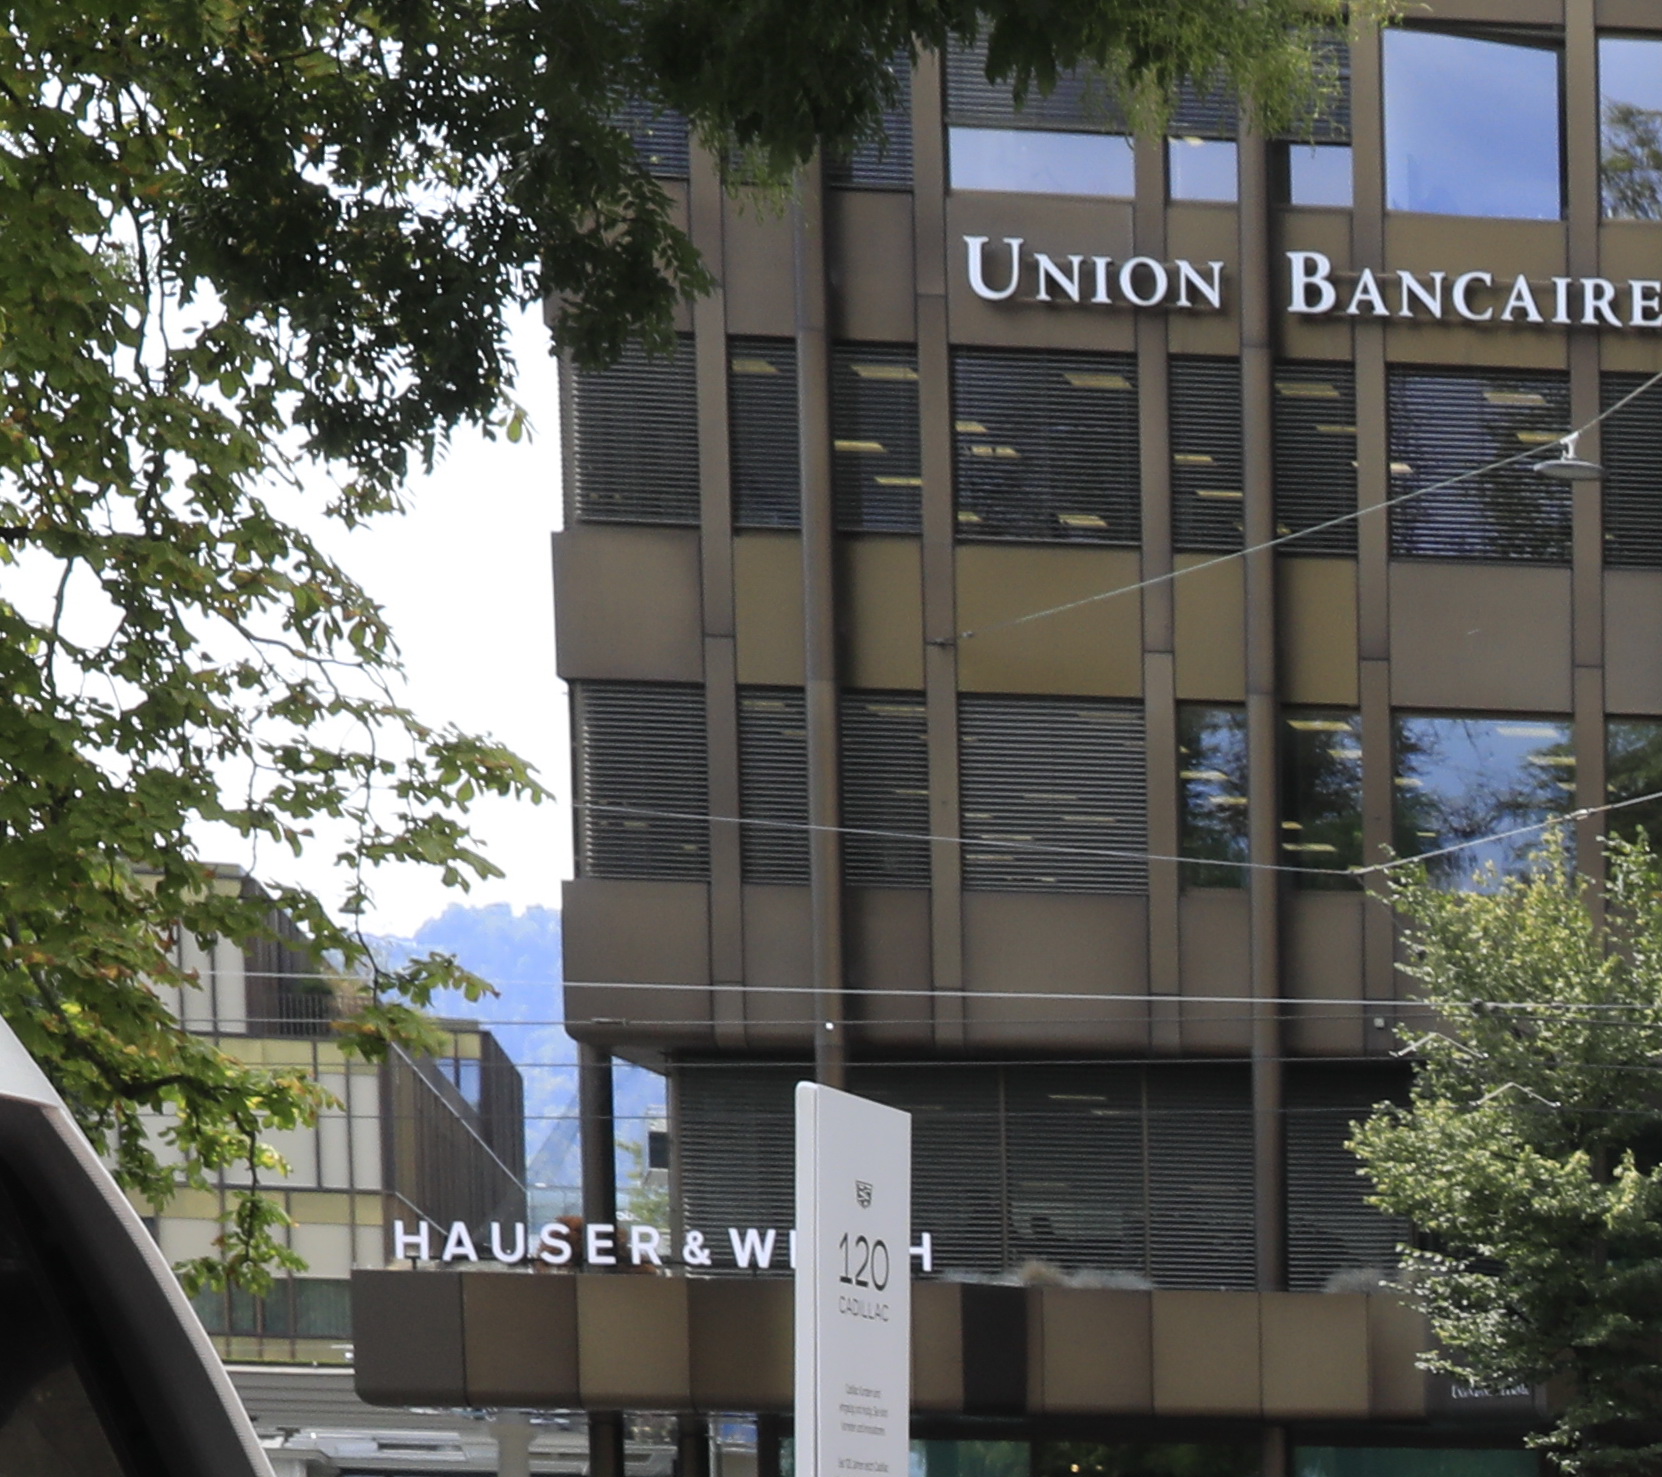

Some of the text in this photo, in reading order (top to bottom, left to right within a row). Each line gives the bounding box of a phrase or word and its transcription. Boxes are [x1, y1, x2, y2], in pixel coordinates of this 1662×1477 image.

[964, 235, 1223, 308] UNION
[394, 1219, 662, 1267] HAUSER
[682, 1230, 711, 1266] &
[839, 1231, 890, 1292] 120
[838, 1296, 890, 1322] CADILLAC
